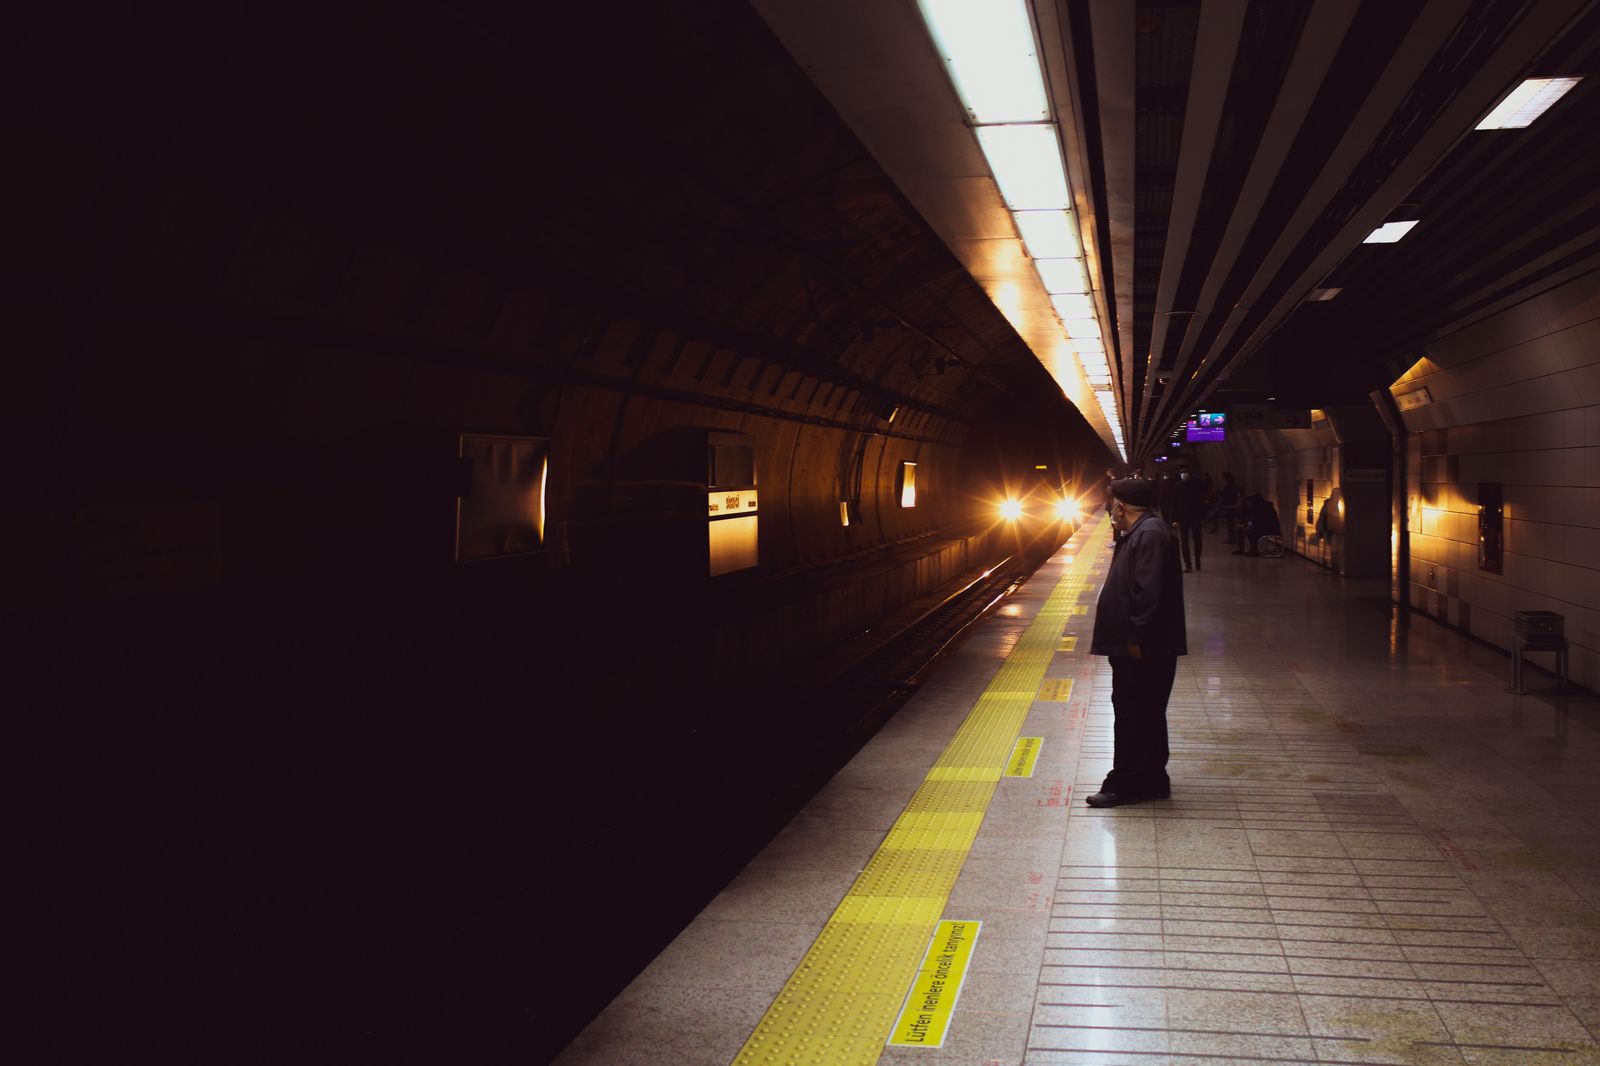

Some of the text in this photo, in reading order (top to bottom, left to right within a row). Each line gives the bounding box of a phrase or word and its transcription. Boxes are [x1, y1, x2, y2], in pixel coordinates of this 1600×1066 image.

[930, 954, 954, 981] öncelik
[917, 980, 945, 1012] inenlere
[905, 1013, 932, 1043] Lütfen
